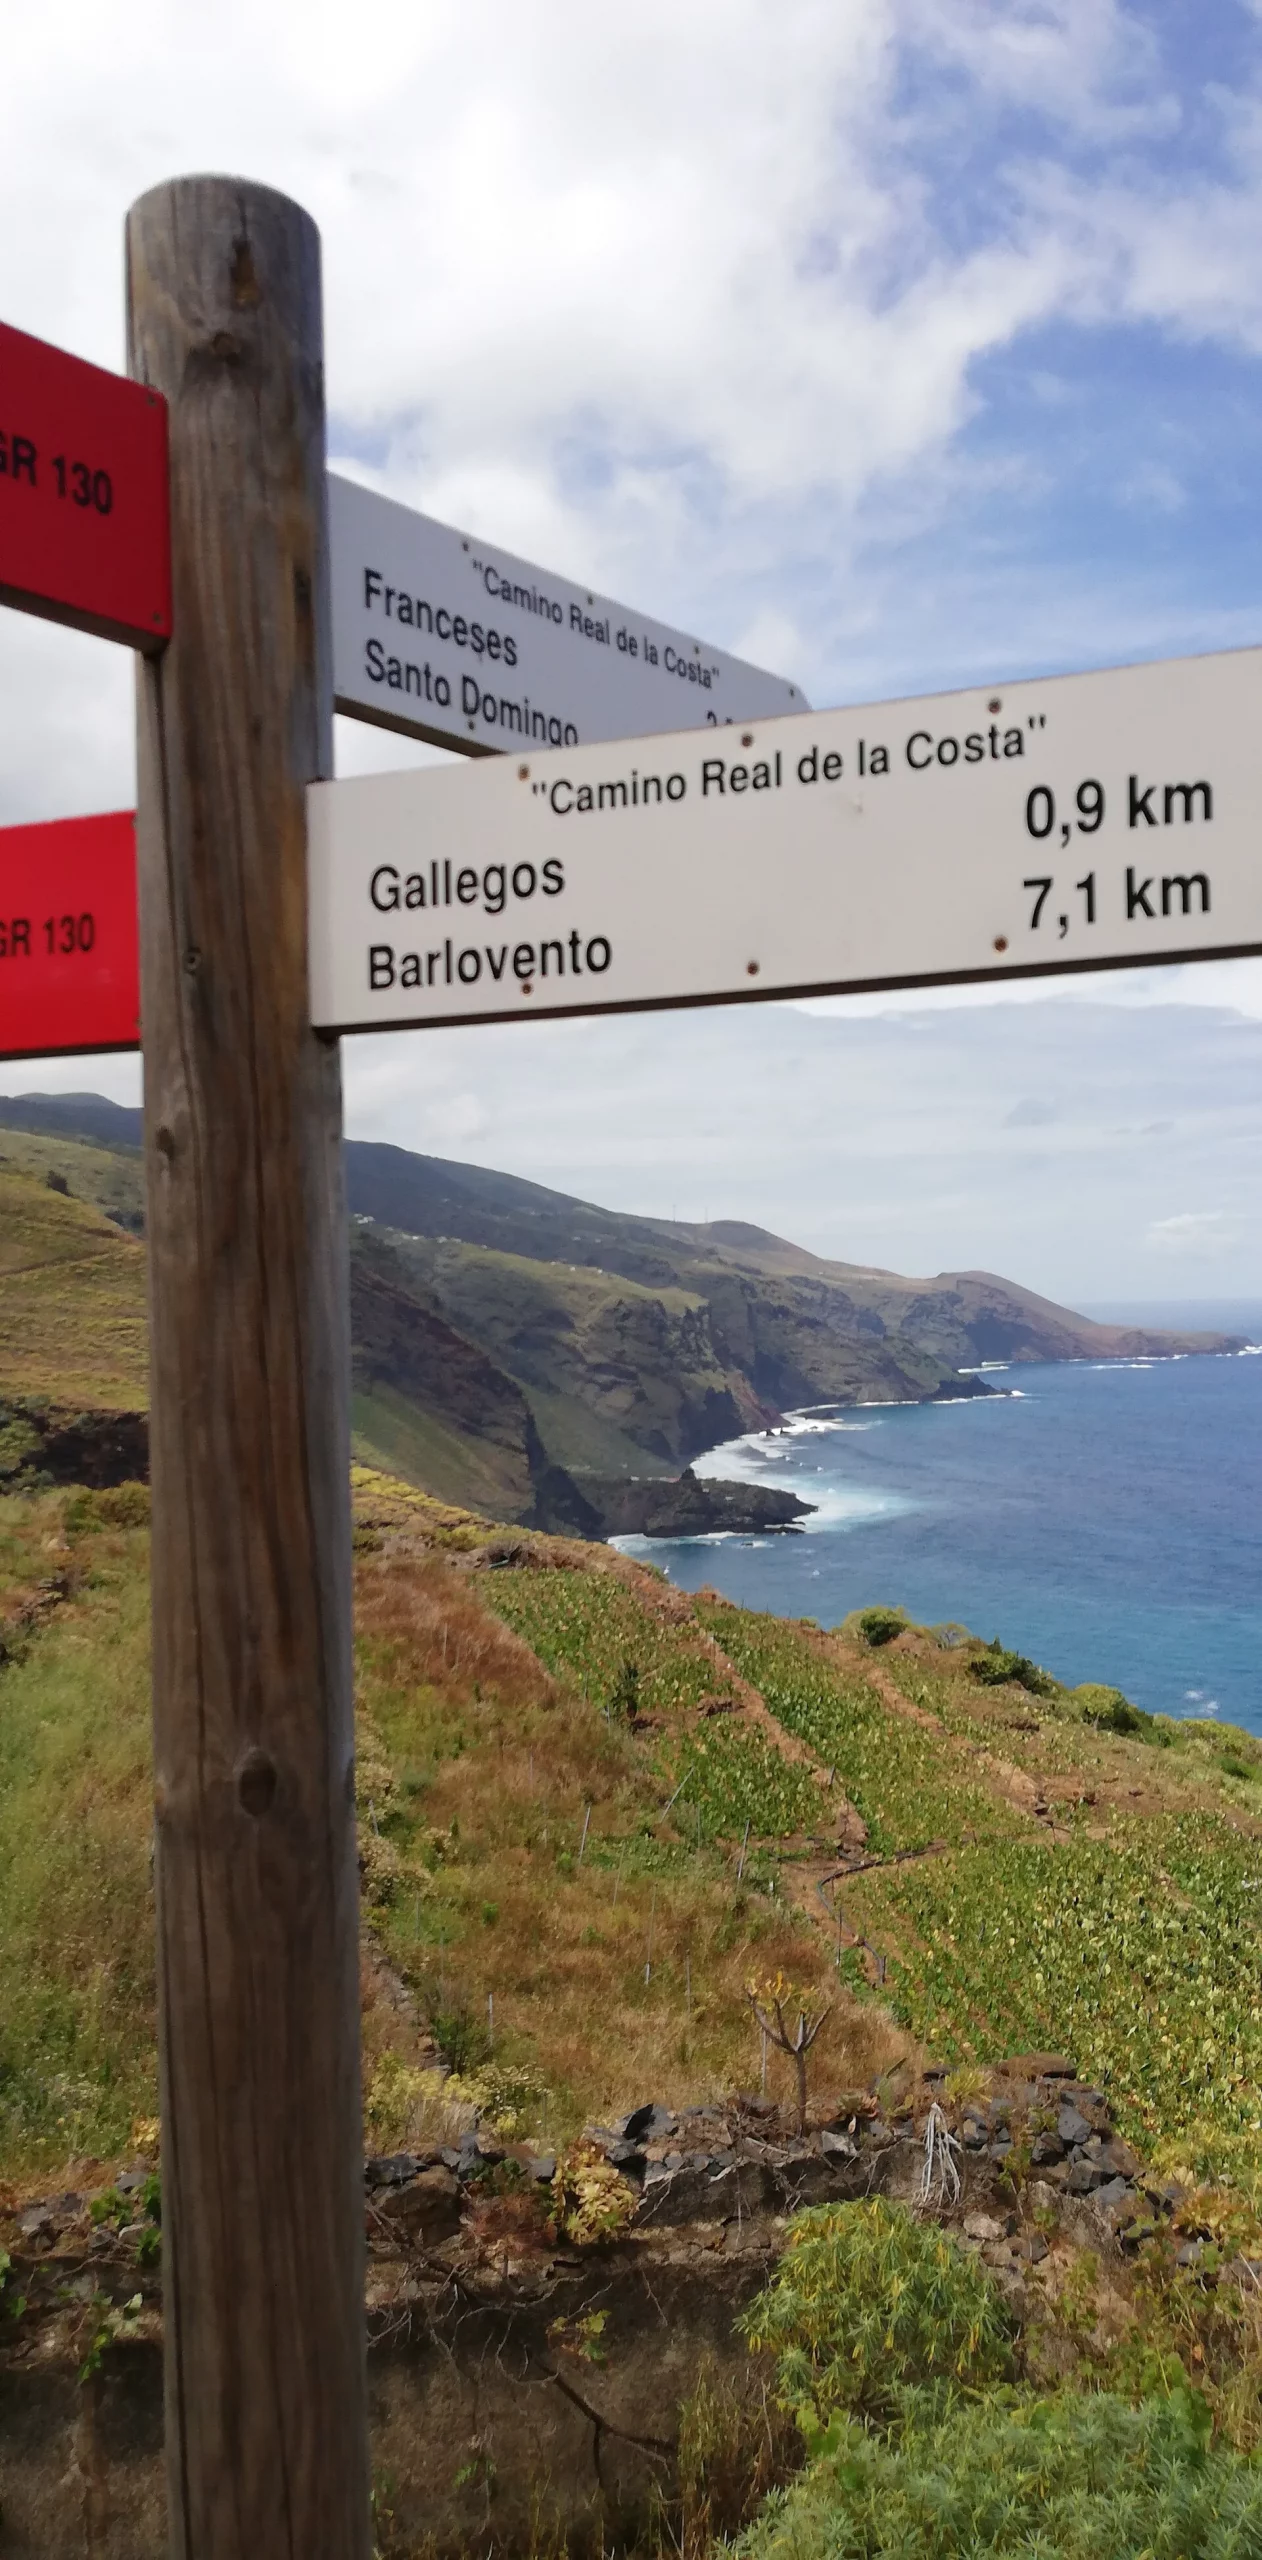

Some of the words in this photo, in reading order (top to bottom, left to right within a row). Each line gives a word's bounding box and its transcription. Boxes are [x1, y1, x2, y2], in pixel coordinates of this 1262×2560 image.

[51, 454, 113, 516] 130
[363, 567, 518, 667] Franceses
[569, 602, 611, 645] Real
[615, 628, 638, 657] de
[643, 637, 659, 666] la
[364, 638, 452, 708] Santo
[532, 770, 687, 815] "Camino
[701, 751, 782, 797] Real
[797, 745, 843, 784] de
[858, 739, 890, 777] la
[905, 715, 1046, 771] Costa"
[369, 859, 565, 913] Gallegos
[1025, 778, 1106, 848] 0,9
[1128, 774, 1213, 829] km
[43, 912, 95, 955] 130
[369, 929, 612, 989] Barlovento
[1023, 871, 1096, 939] 7,1
[1125, 866, 1211, 921] km
